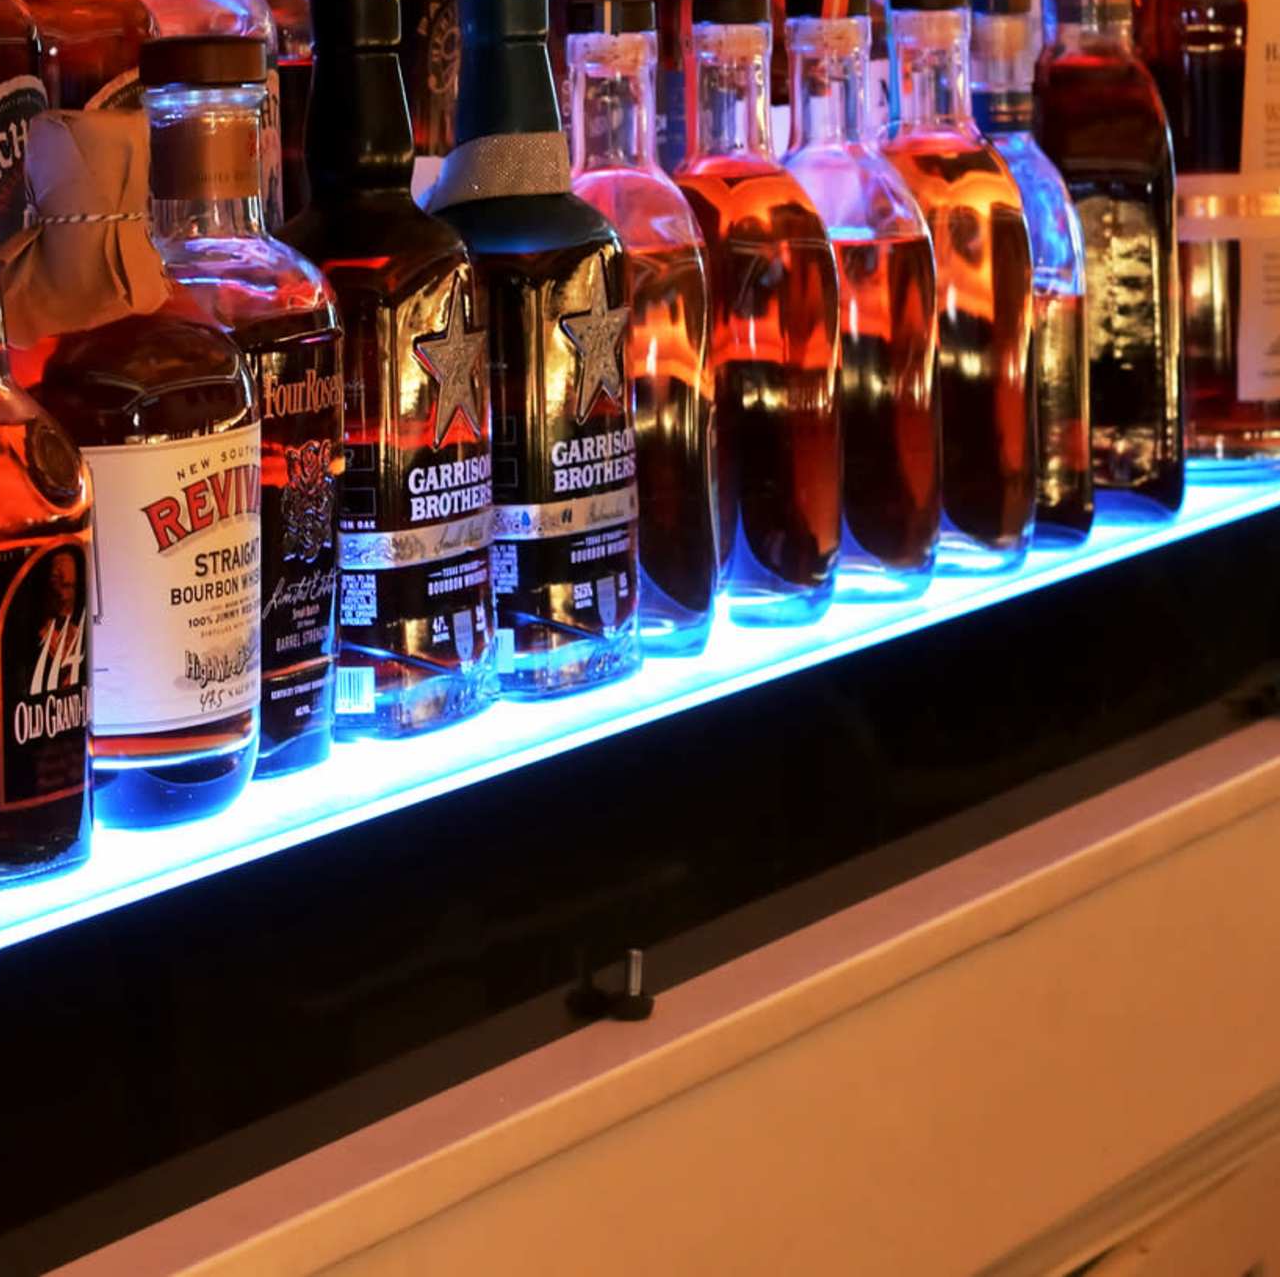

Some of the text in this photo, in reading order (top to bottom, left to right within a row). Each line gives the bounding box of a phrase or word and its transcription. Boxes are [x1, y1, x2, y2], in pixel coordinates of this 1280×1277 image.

[264, 372, 306, 419] Four
[176, 458, 210, 482] NEW
[554, 454, 636, 493] BROTHERS
[410, 479, 492, 522] BROTHERS
[570, 546, 606, 565] BOURBON
[170, 575, 239, 607] BOURBON
[428, 577, 464, 597] BOURBON
[29, 607, 85, 696] 114
[14, 700, 44, 745] OLD
